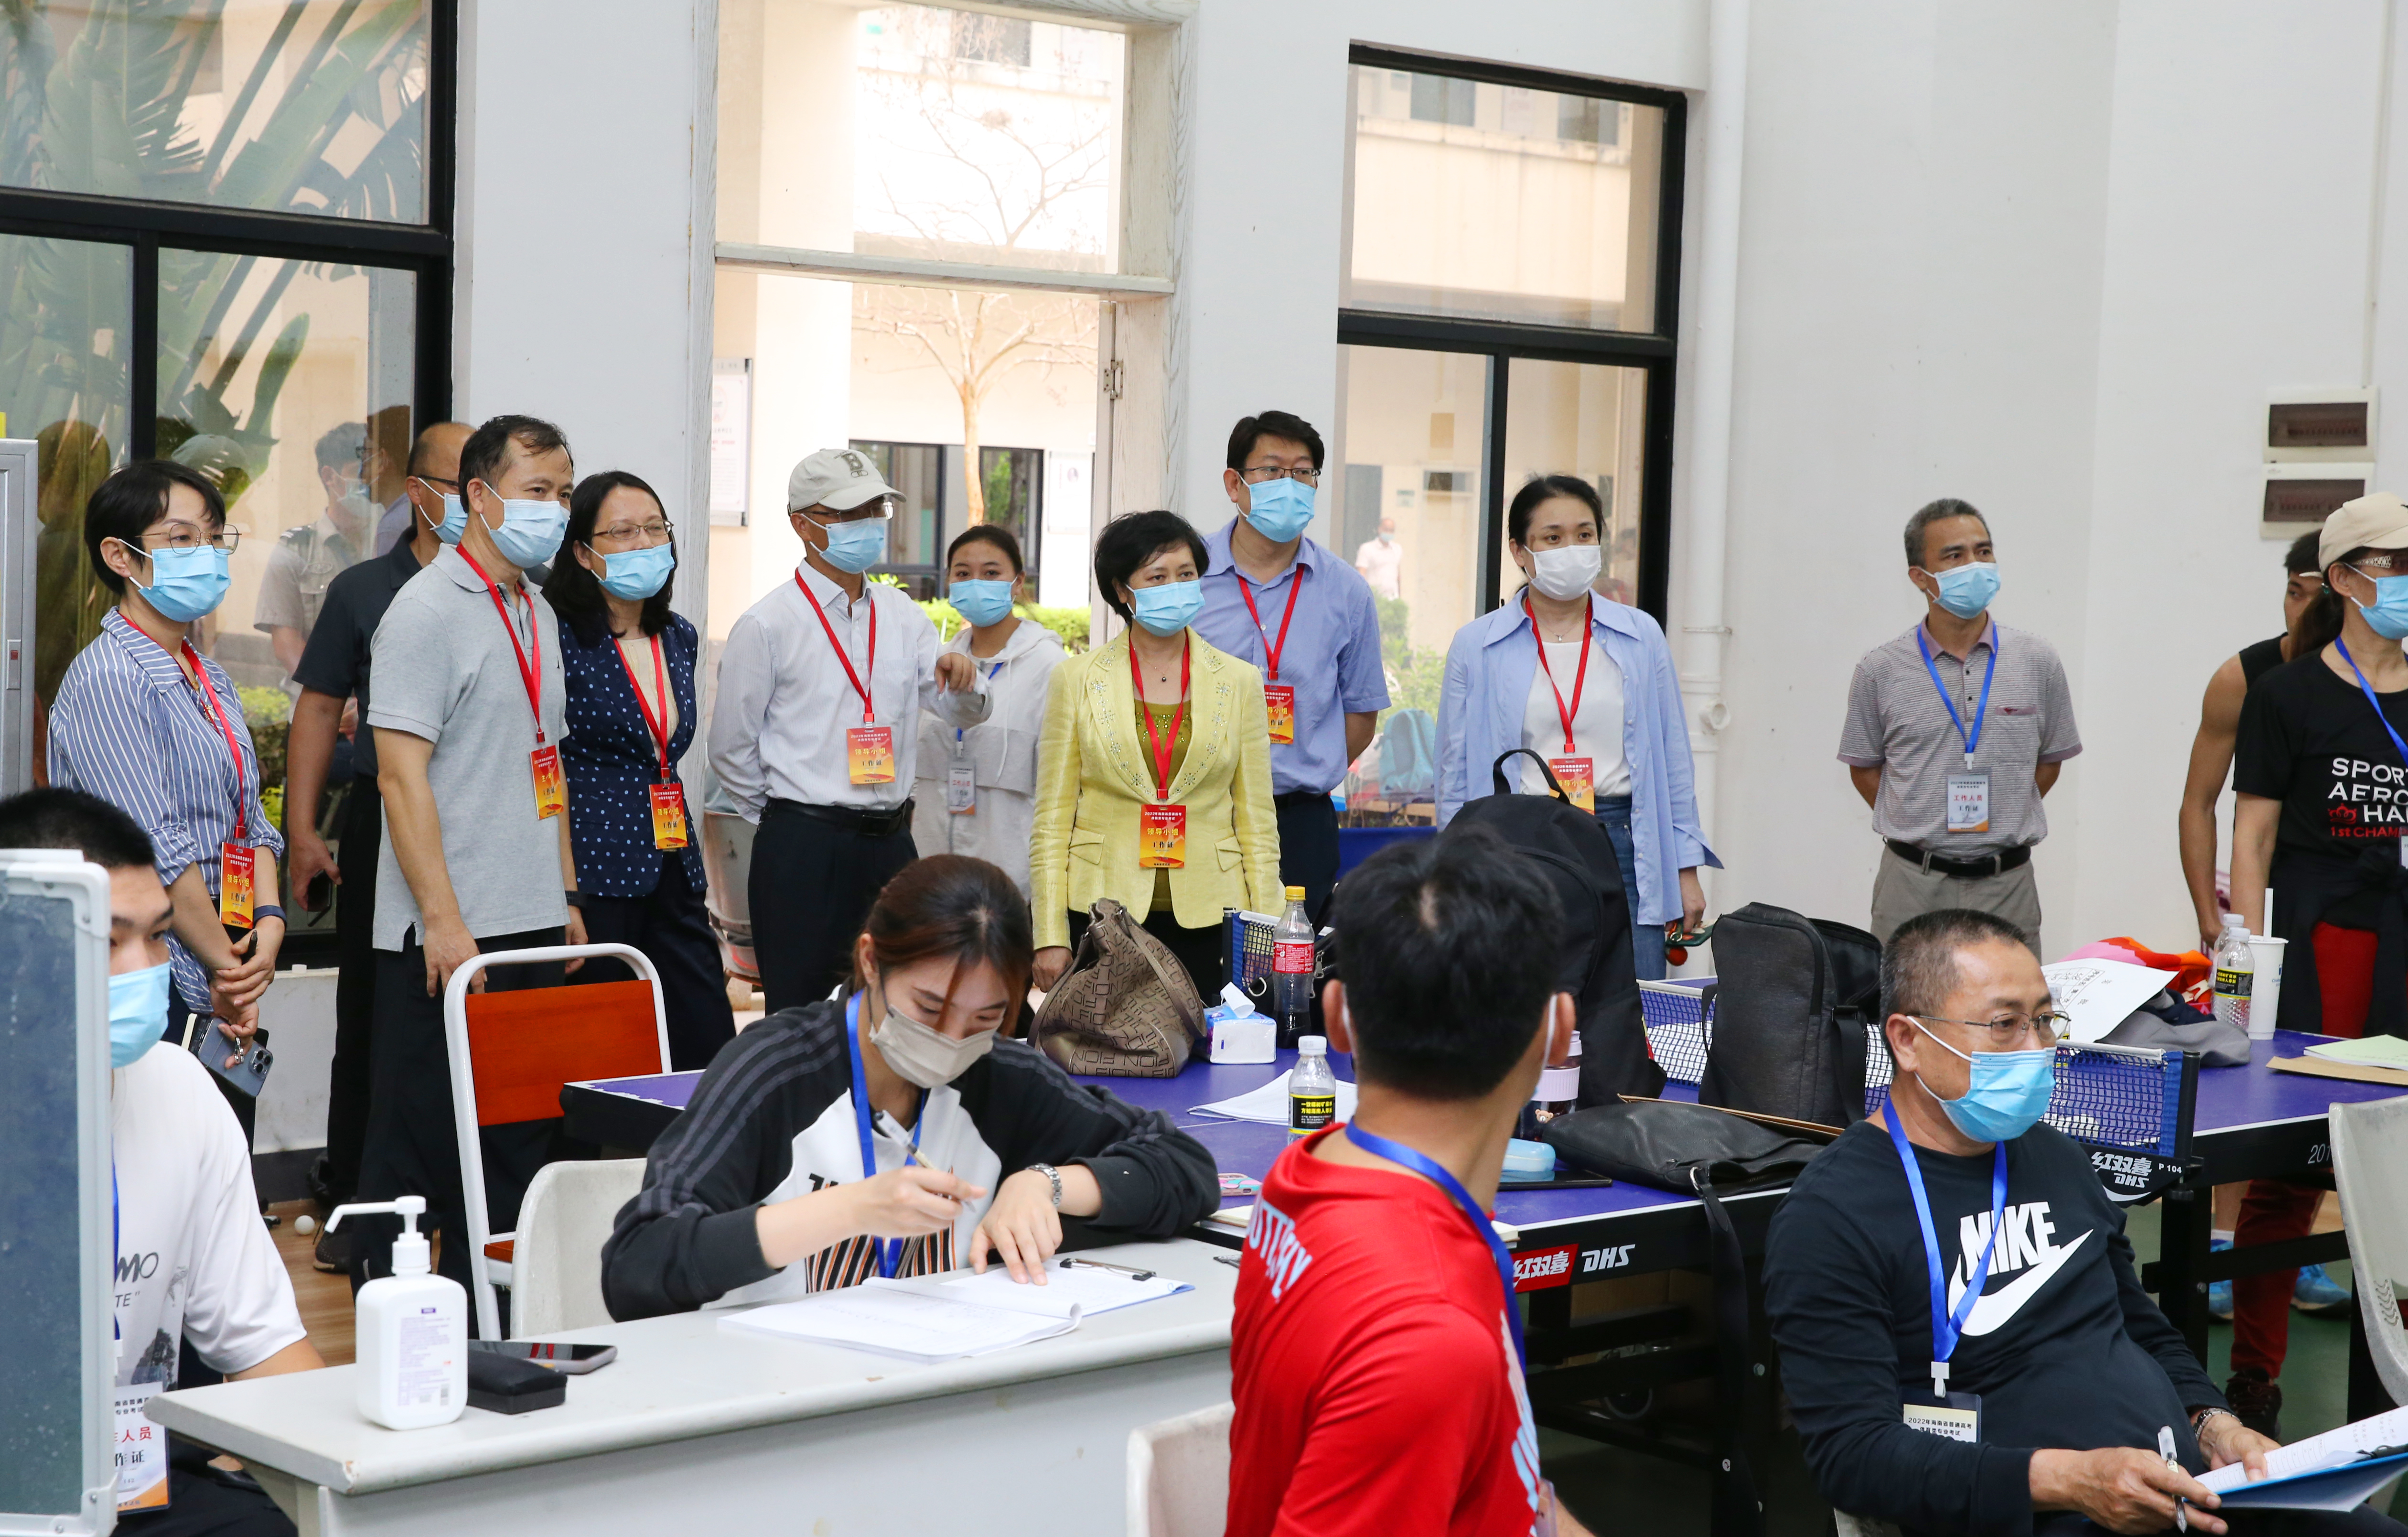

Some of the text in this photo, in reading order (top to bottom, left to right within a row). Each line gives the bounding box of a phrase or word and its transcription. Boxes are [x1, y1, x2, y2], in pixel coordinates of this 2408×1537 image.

[854, 747, 886, 755] 领导小组
[2332, 758, 2408, 786] SPOR
[657, 807, 680, 815] 领导小组
[2363, 805, 2408, 823] HA
[1147, 827, 1179, 835] 领导小组
[2331, 826, 2351, 837] 1st
[226, 874, 250, 888] 领导小组
[230, 892, 246, 903] 工作证
[2091, 1151, 2152, 1177] 红双喜
[2159, 1162, 2182, 1174] P 104
[2113, 1172, 2150, 1189] DHS
[1960, 1201, 2061, 1281] NIKE
[1581, 1244, 1636, 1273] DHS
[1908, 1417, 1972, 1429] 2022年海南省普通高考
